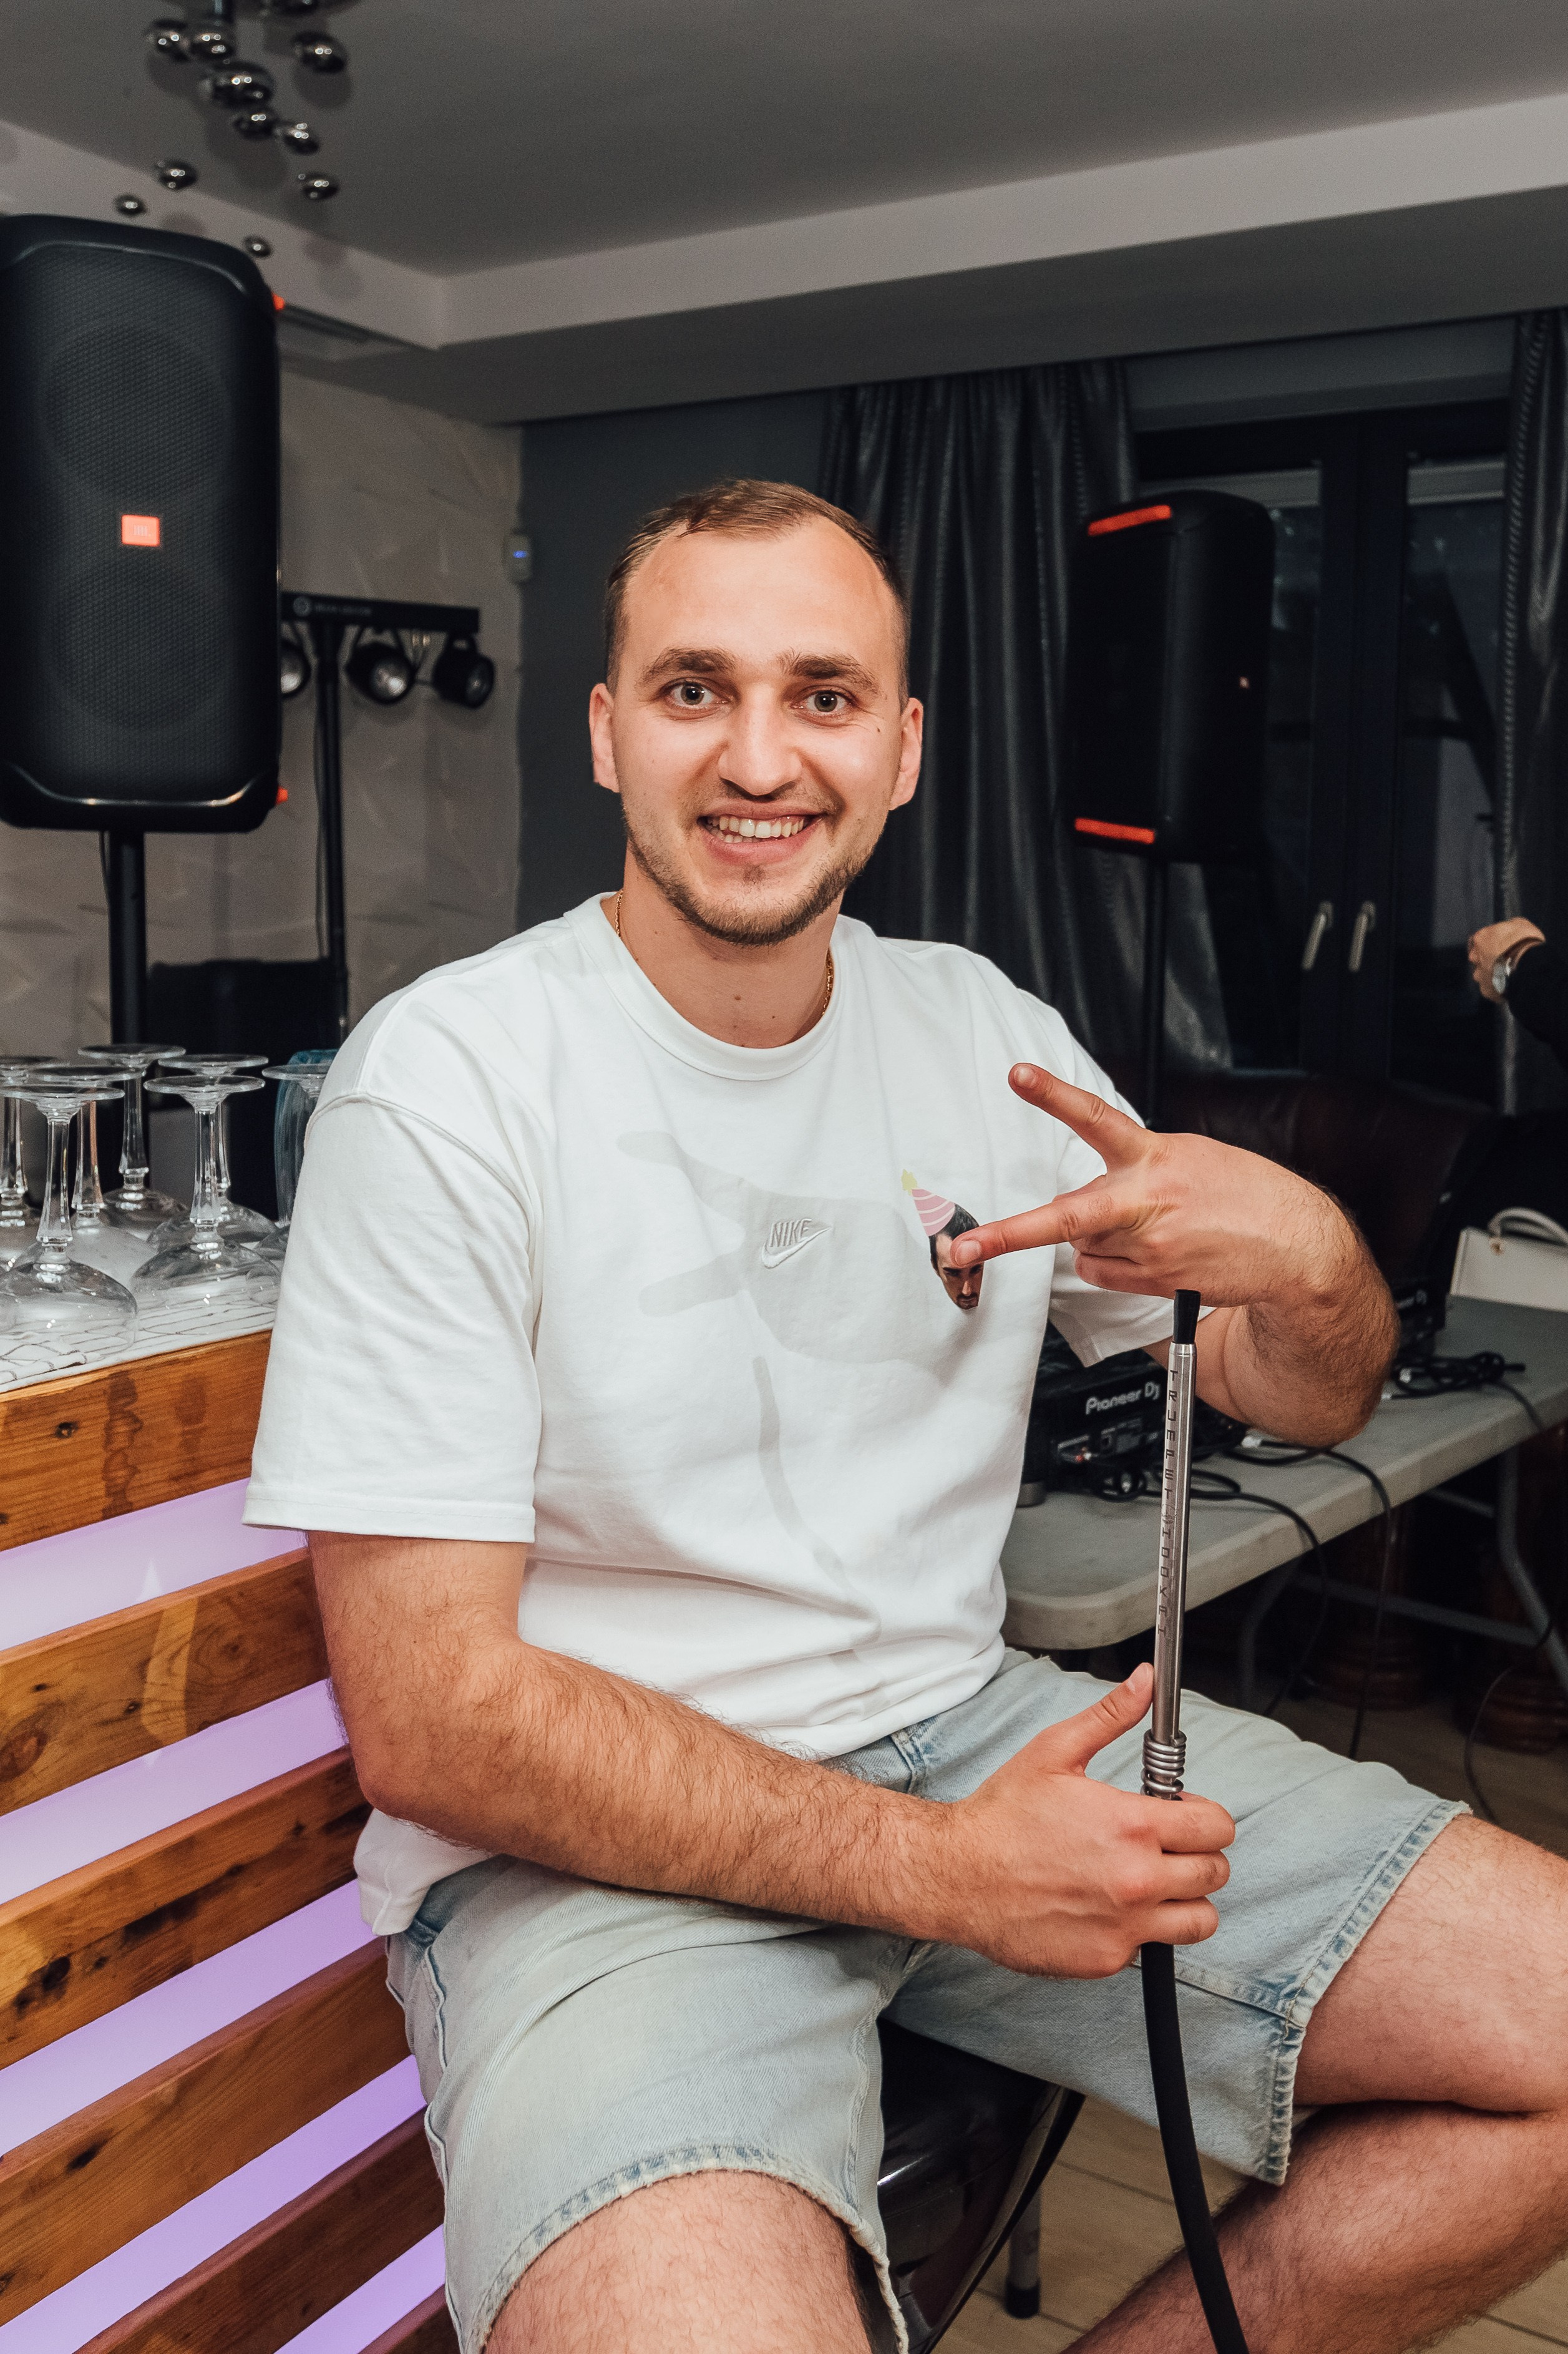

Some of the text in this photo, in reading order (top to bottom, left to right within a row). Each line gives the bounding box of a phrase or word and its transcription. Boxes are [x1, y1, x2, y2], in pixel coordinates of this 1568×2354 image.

[768, 1217, 813, 1248] NIKE
[1086, 1389, 1142, 1415] Pioneer
[1157, 1369, 1179, 1638] TRUMPET HOOKAH
